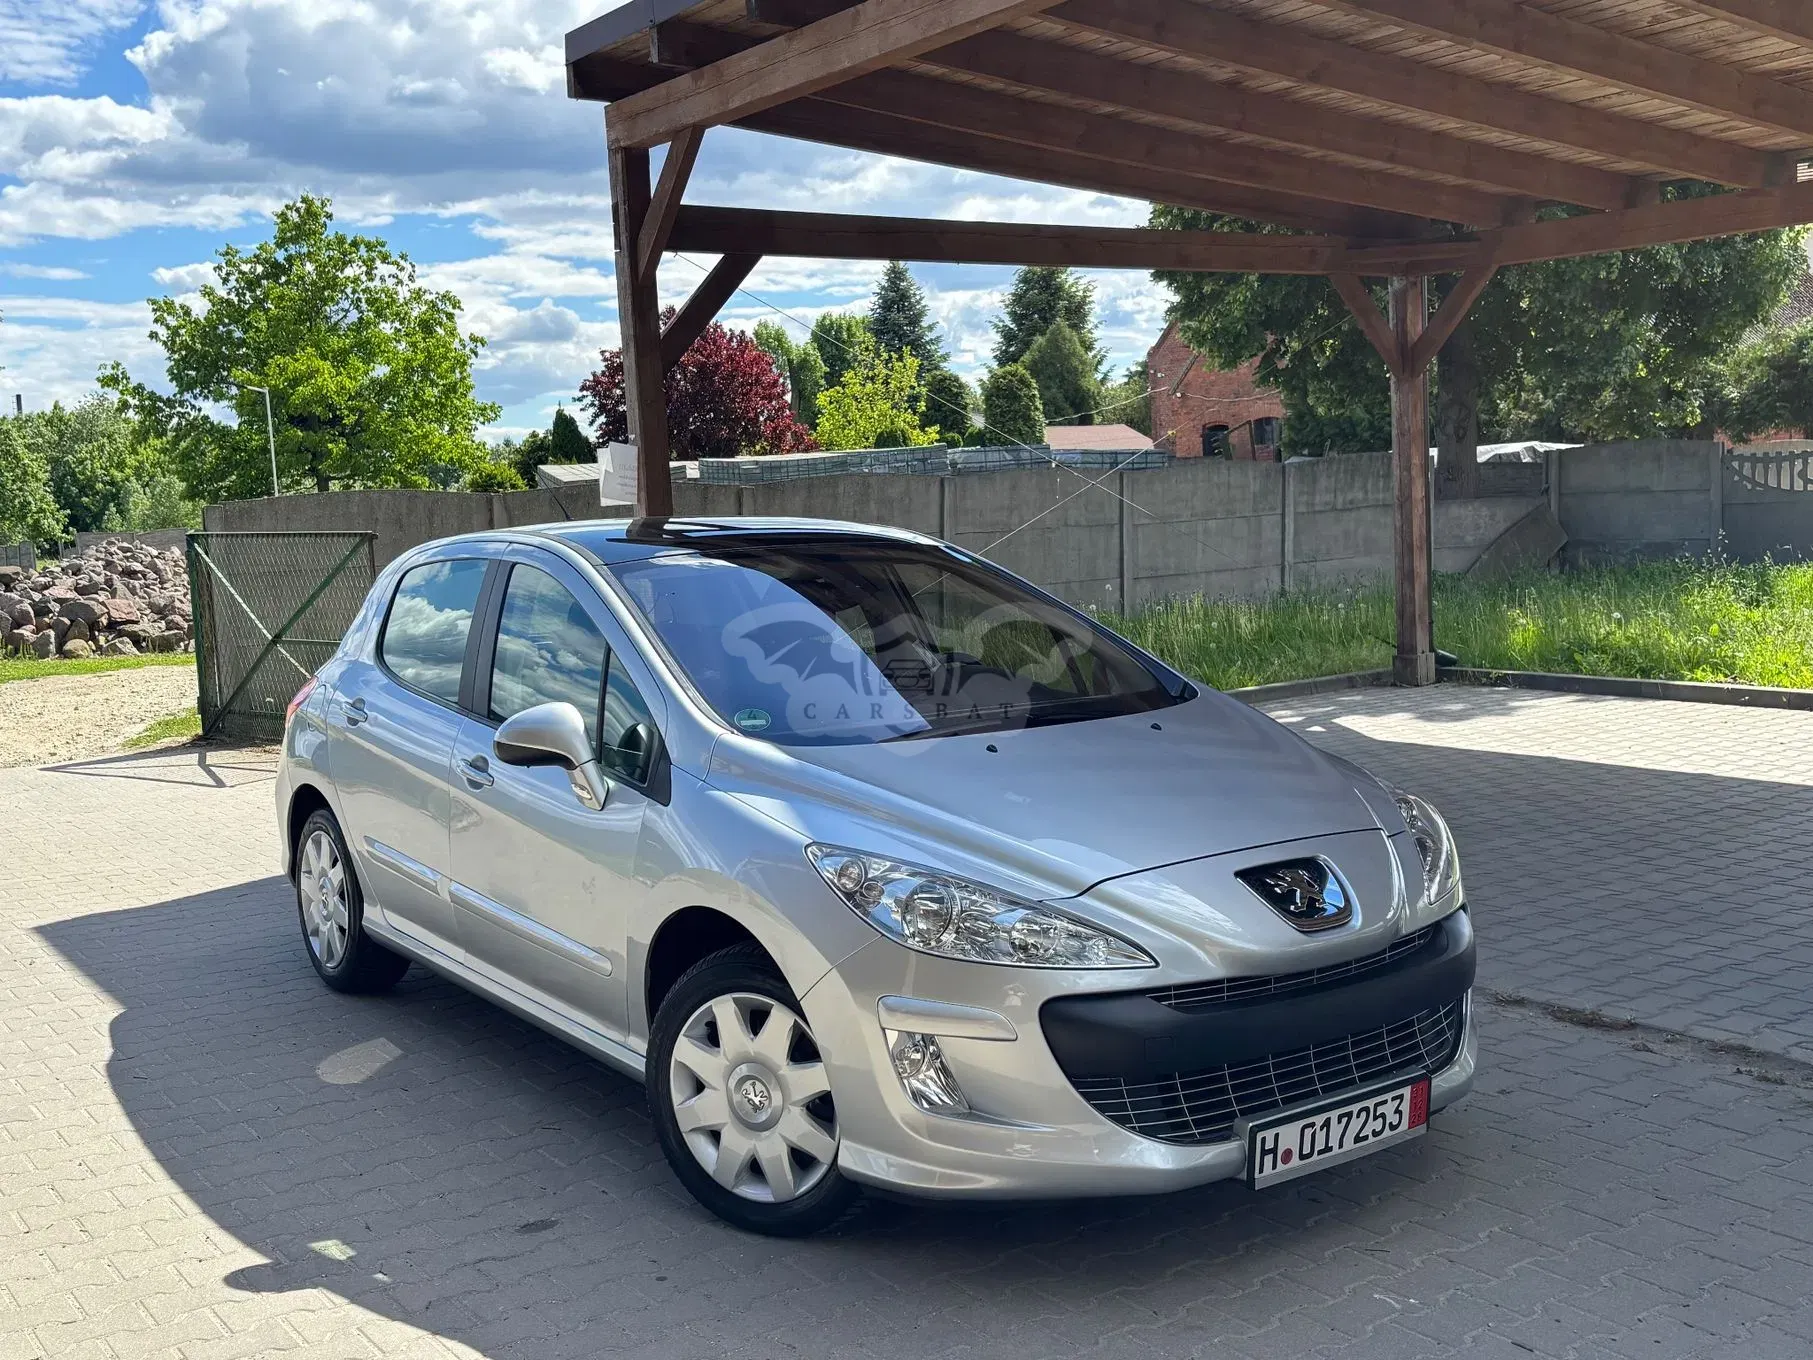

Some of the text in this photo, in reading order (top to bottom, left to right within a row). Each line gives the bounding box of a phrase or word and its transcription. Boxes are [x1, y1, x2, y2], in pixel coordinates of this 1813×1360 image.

[747, 709, 757, 720] 4
[1259, 1093, 1405, 1175] H 017253
